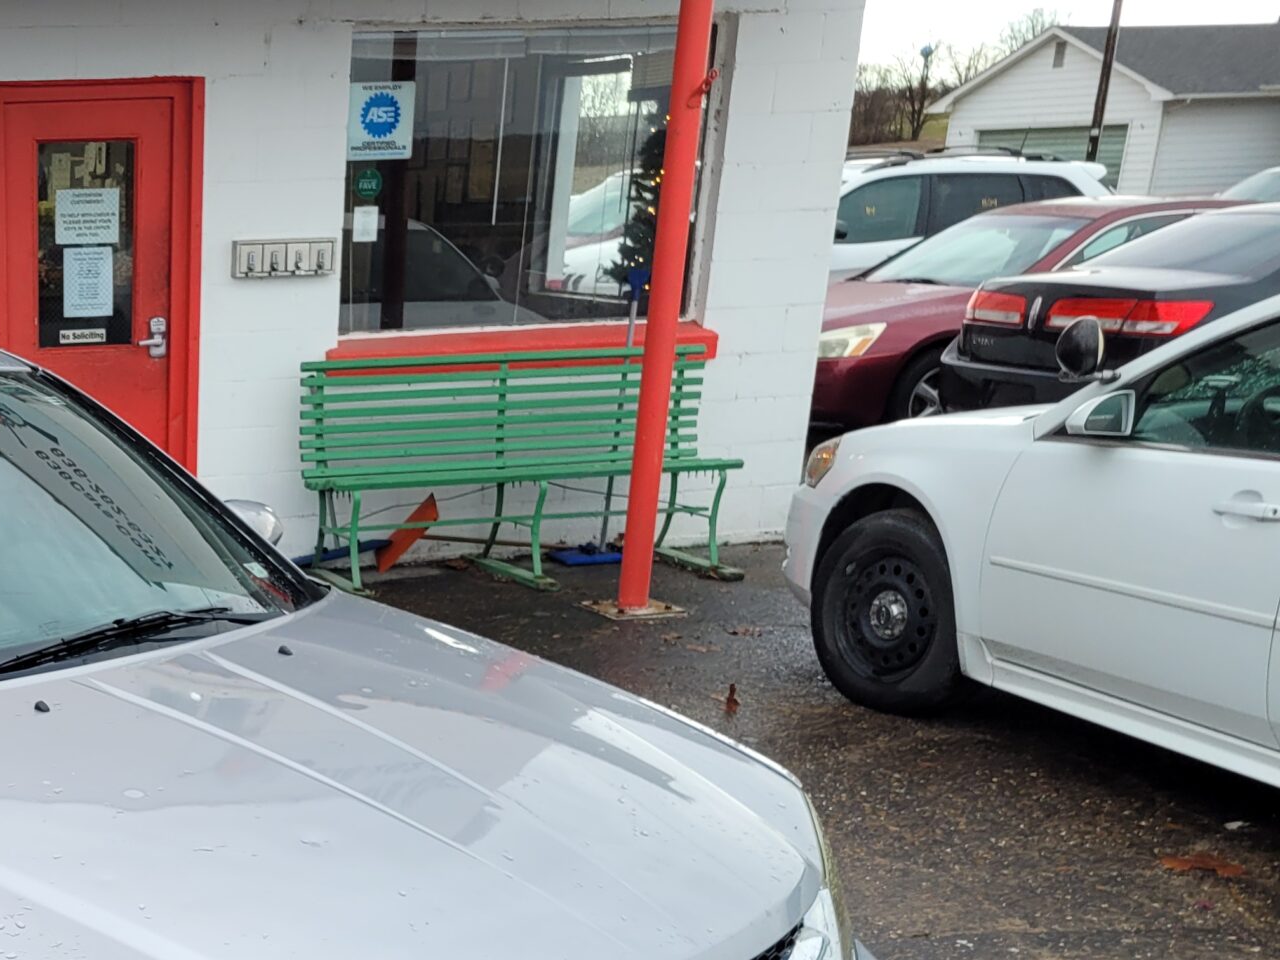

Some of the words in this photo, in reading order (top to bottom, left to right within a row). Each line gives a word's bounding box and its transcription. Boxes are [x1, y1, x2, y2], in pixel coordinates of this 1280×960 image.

[365, 106, 396, 124] ASE
[60, 332, 70, 340] No
[71, 331, 105, 341] Soliciting
